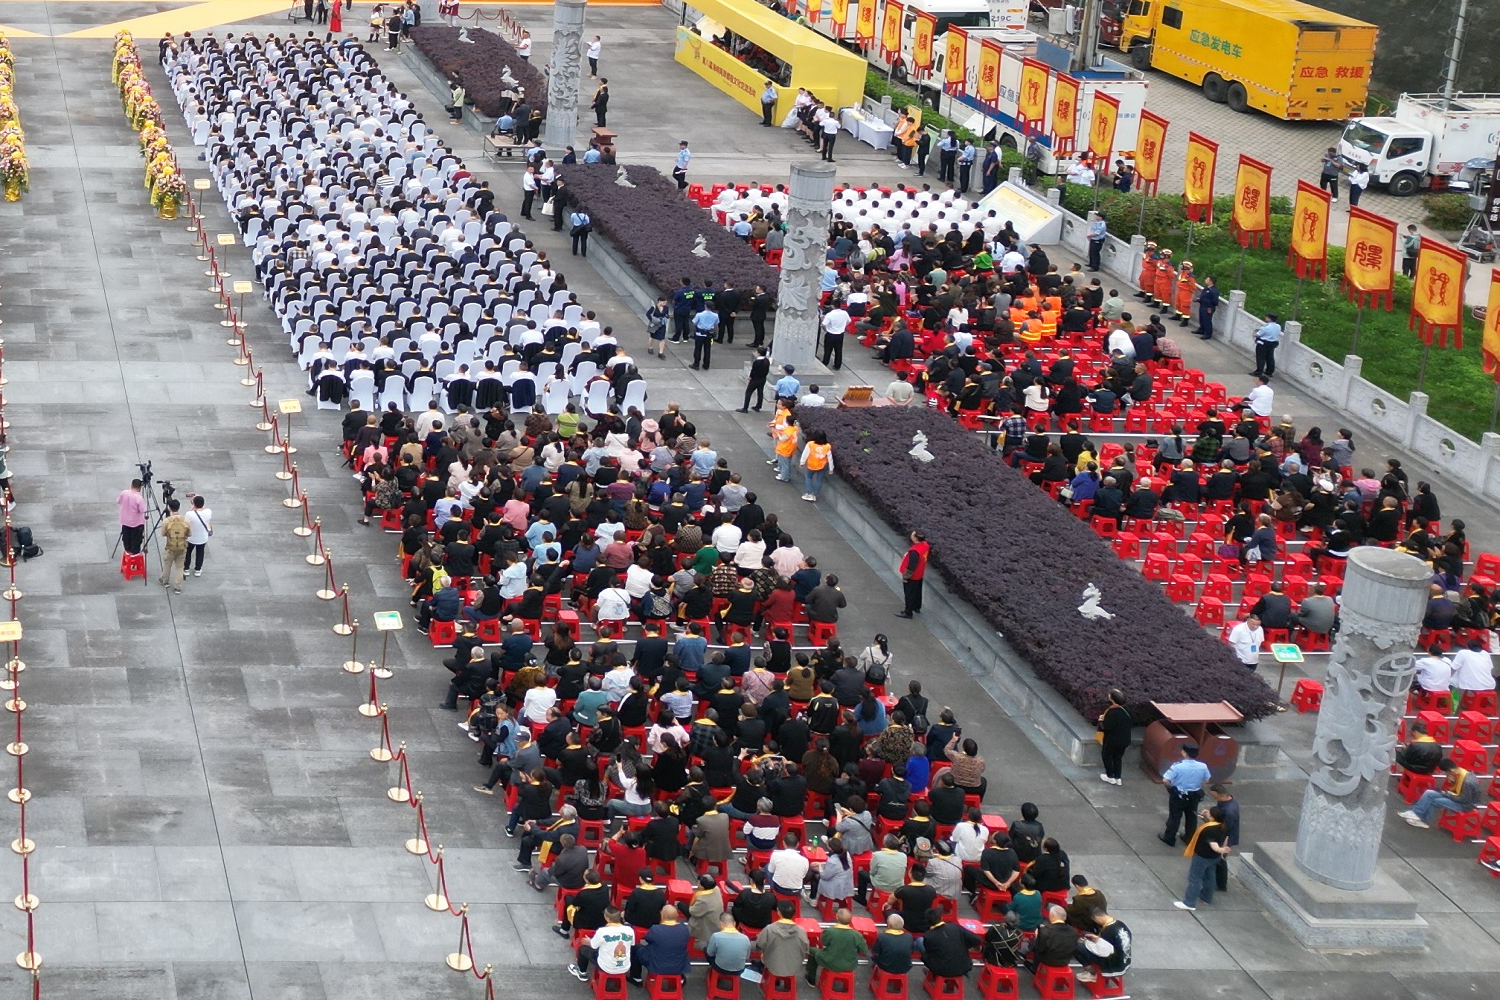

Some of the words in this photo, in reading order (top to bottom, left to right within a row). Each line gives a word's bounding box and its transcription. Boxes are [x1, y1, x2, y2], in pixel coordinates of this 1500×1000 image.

[1189, 28, 1243, 59] 应急发电车
[1300, 66, 1329, 79] 应急
